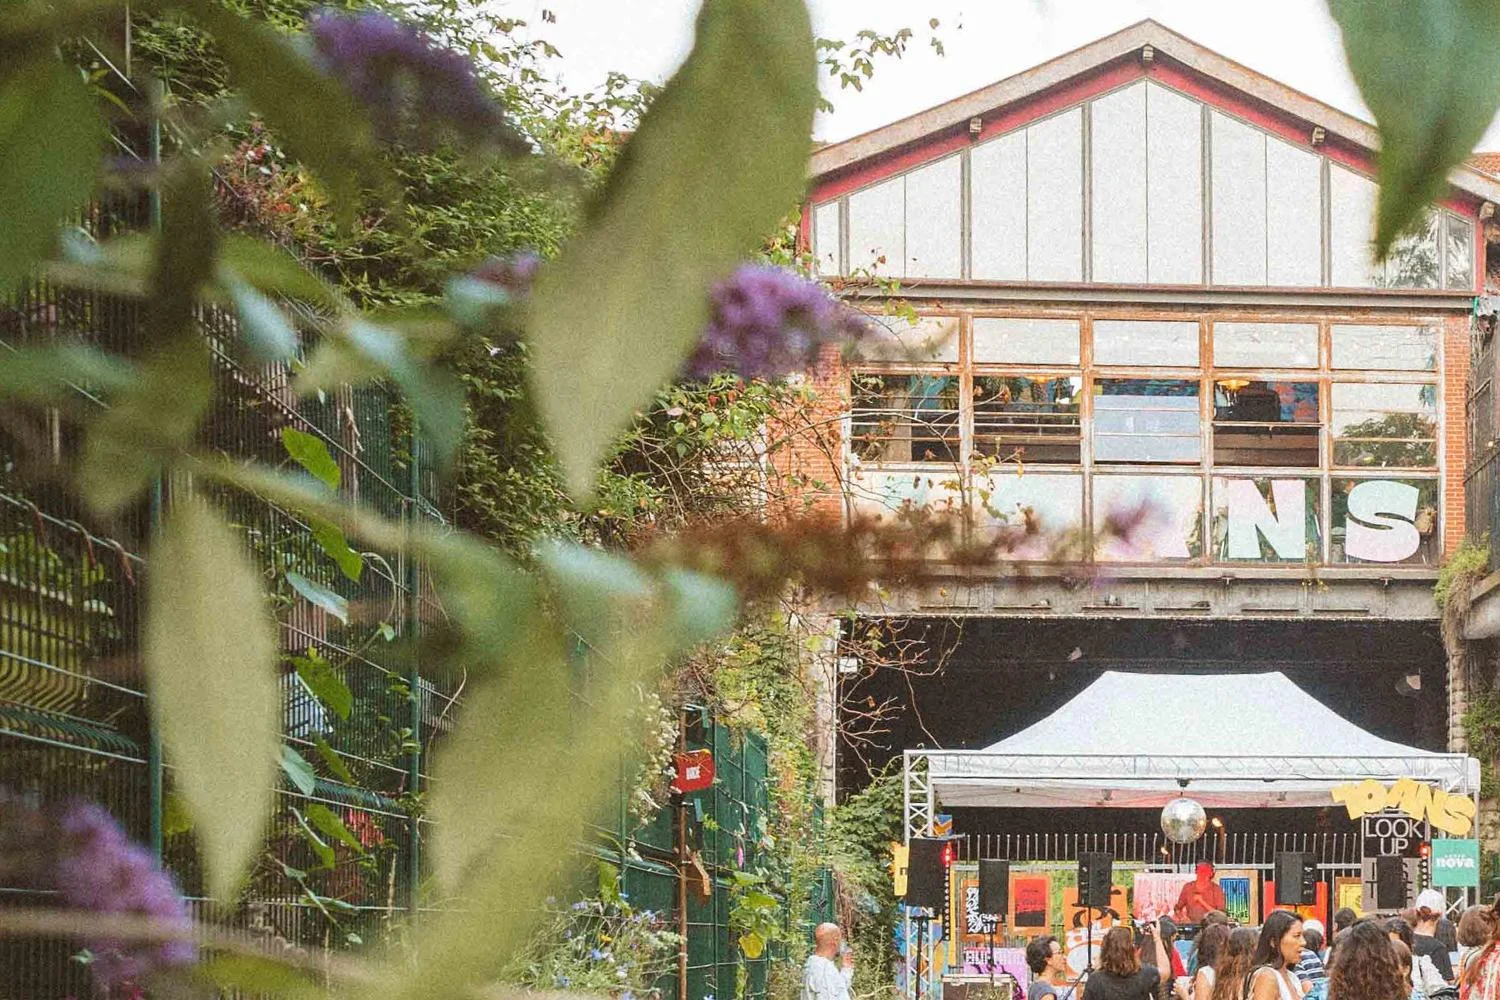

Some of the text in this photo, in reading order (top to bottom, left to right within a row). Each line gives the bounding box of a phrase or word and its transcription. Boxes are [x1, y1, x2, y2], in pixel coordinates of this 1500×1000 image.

[1365, 818, 1423, 838] LOOK
[1380, 837, 1409, 856] UP
[1436, 857, 1475, 868] nova
